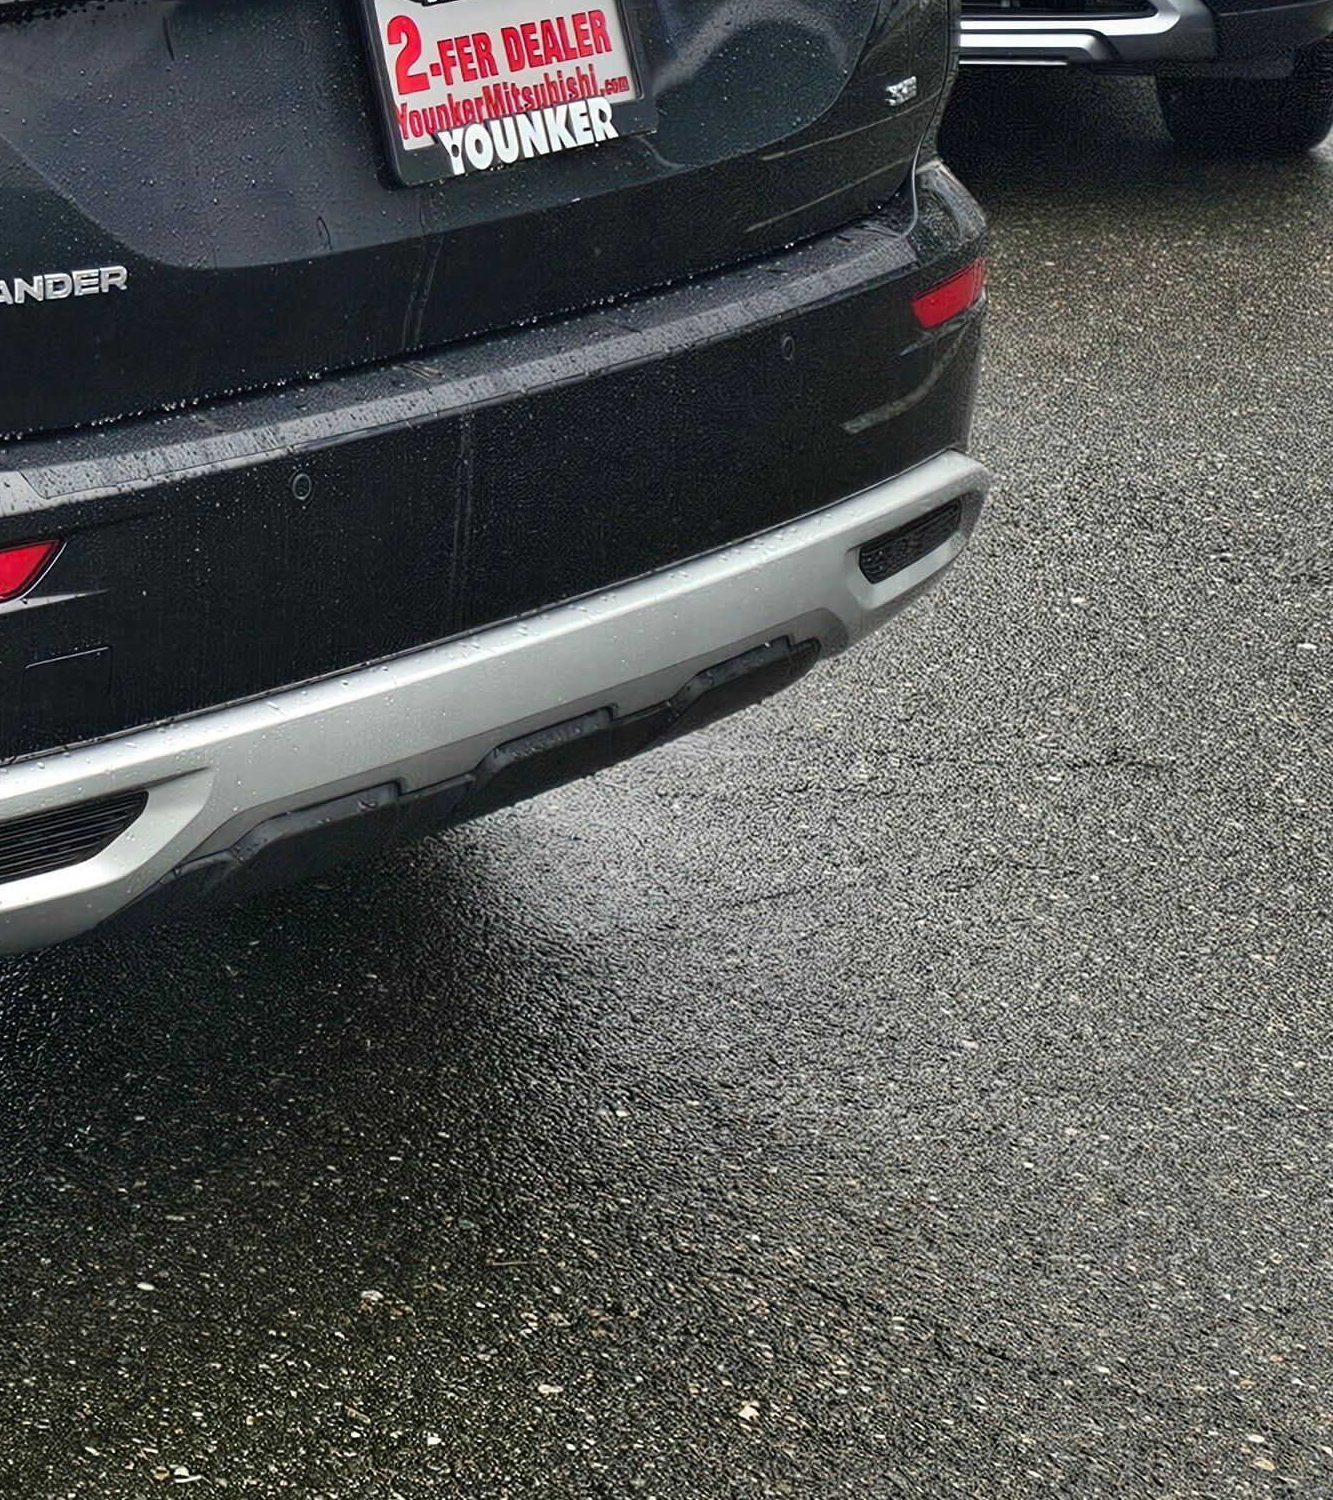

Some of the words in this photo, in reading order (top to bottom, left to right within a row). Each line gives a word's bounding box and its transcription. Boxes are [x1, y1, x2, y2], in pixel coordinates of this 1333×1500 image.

[387, 14, 499, 95] 2-FER
[501, 9, 613, 73] DEALER
[394, 63, 631, 140] YounkerMitsubishi.com
[437, 96, 619, 176] YOUNKER
